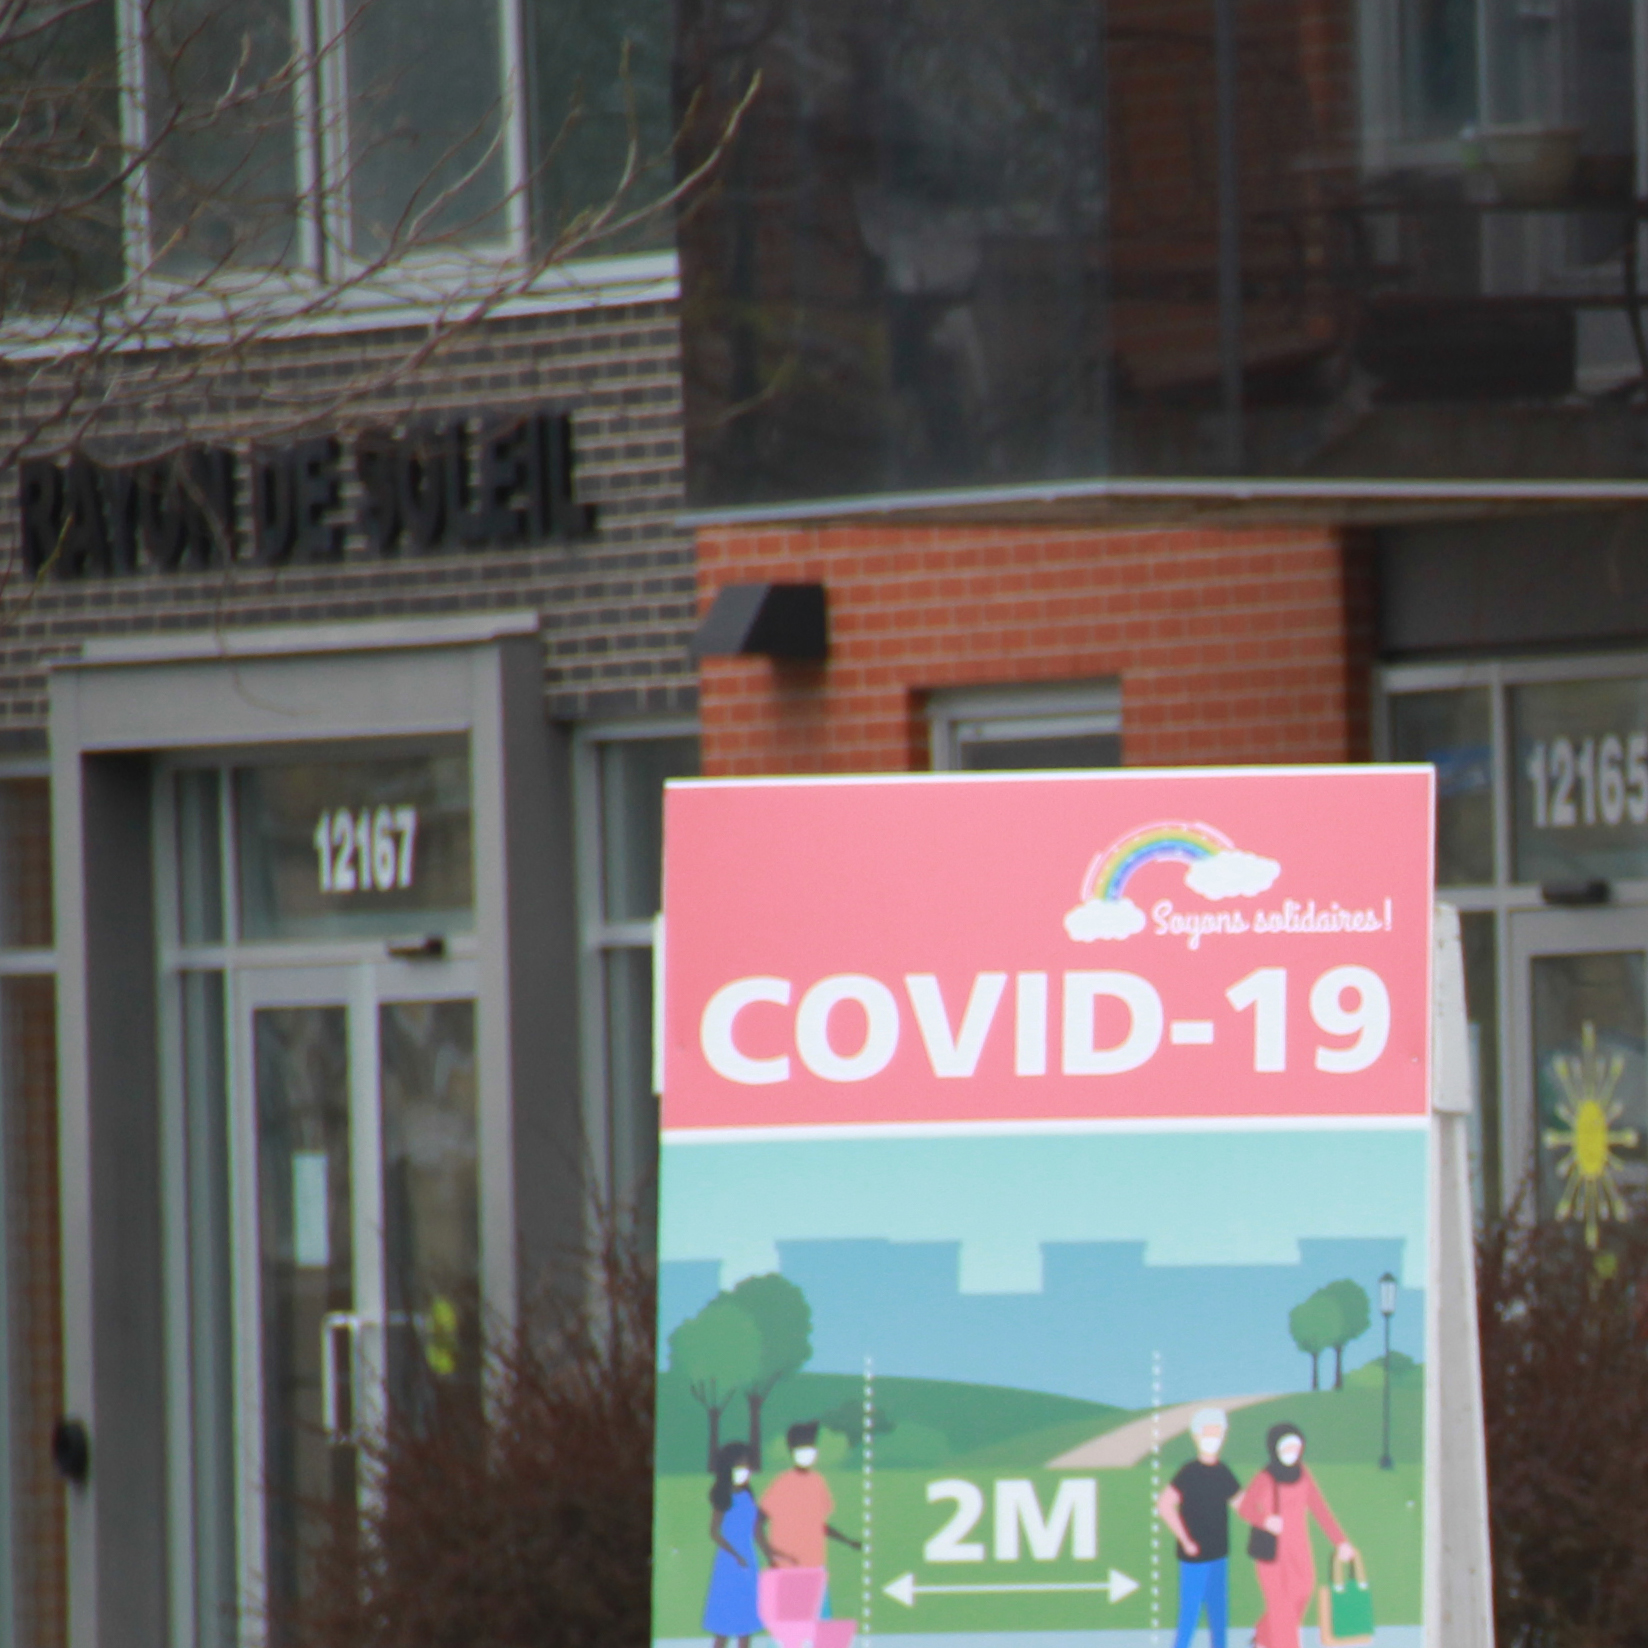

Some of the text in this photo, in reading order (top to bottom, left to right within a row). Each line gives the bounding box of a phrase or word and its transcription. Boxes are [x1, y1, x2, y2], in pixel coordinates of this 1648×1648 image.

[252, 434, 345, 567] DE
[355, 410, 600, 556] SOLEIL
[314, 806, 416, 892] 12167
[1152, 899, 1250, 950] Soyons
[699, 963, 1392, 1085] COVID-19
[923, 1477, 1098, 1563] 2M
